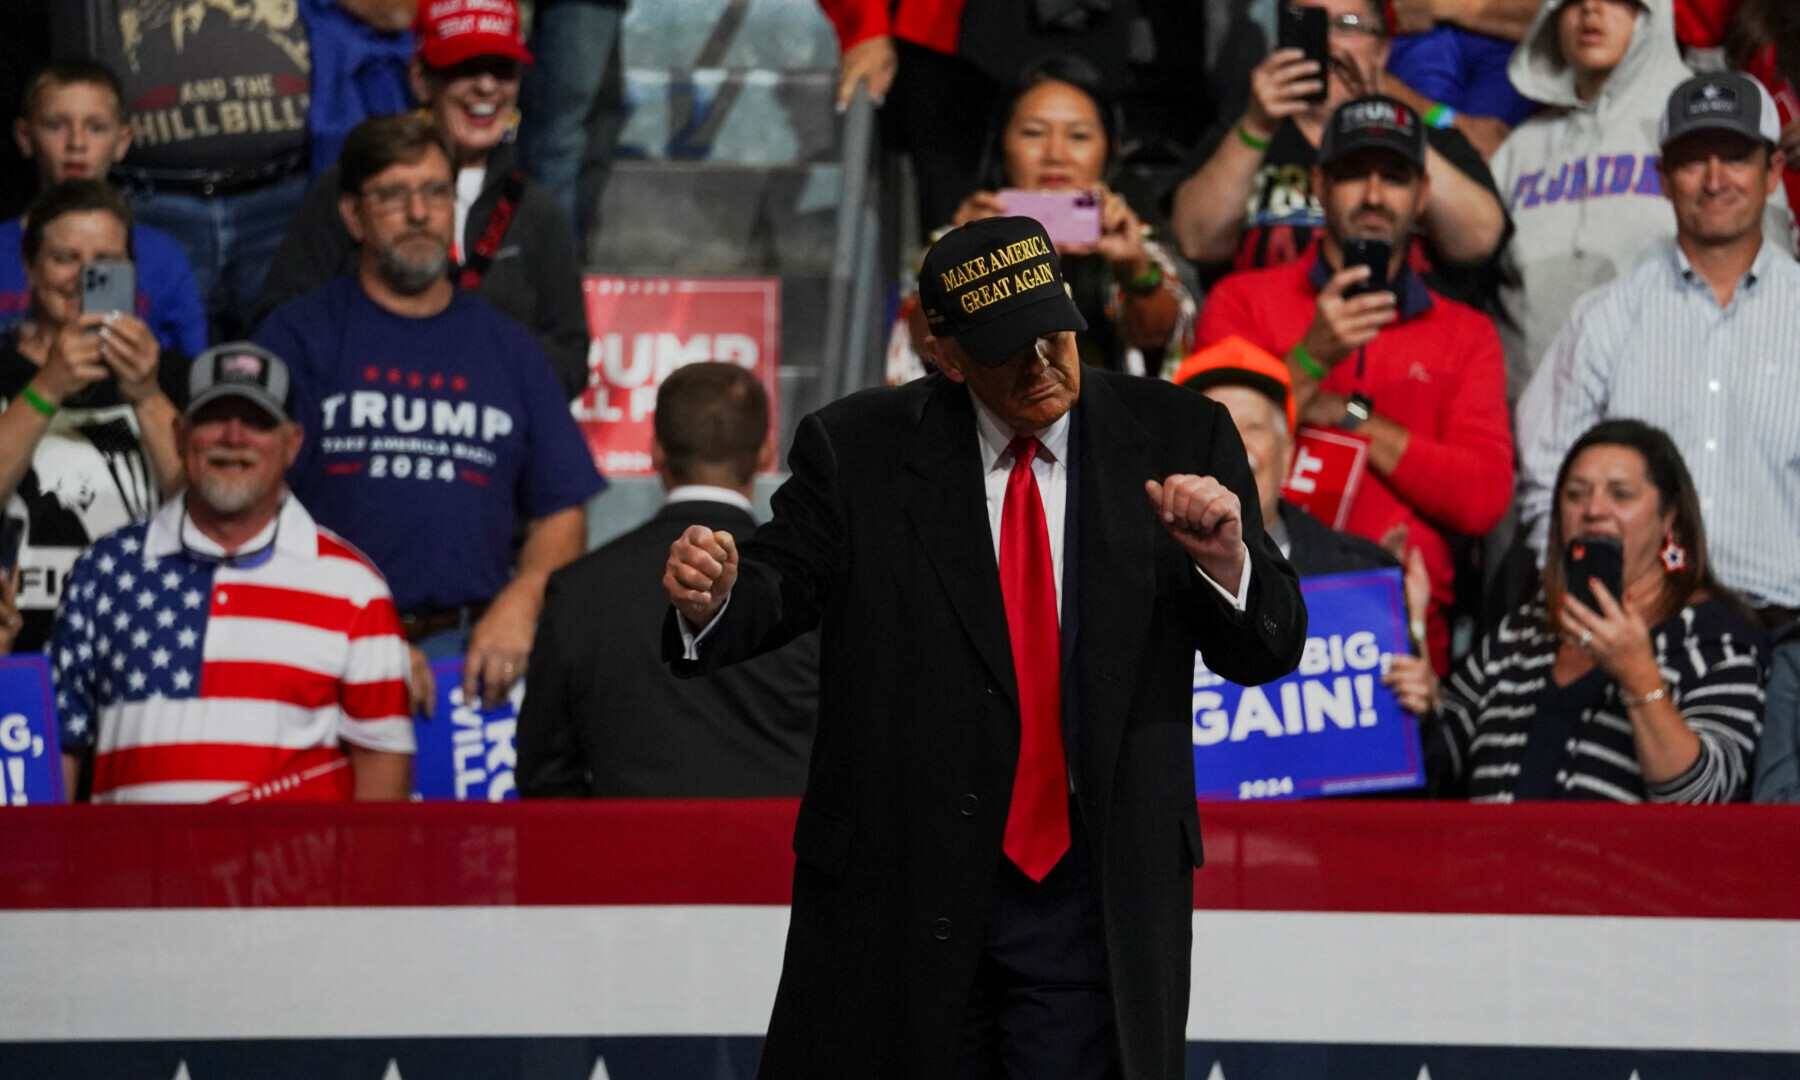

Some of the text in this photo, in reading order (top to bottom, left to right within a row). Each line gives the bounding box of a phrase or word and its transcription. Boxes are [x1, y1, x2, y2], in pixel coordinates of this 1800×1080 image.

[180, 74, 274, 104] AND THE
[940, 236, 1050, 292] MAKE AMERICA
[961, 262, 1054, 314] GREAT AGAIN
[320, 390, 513, 443] TRUMP
[369, 454, 456, 483] 2024
[370, 436, 450, 456] AMERICA
[1192, 674, 1378, 746] GAIN!
